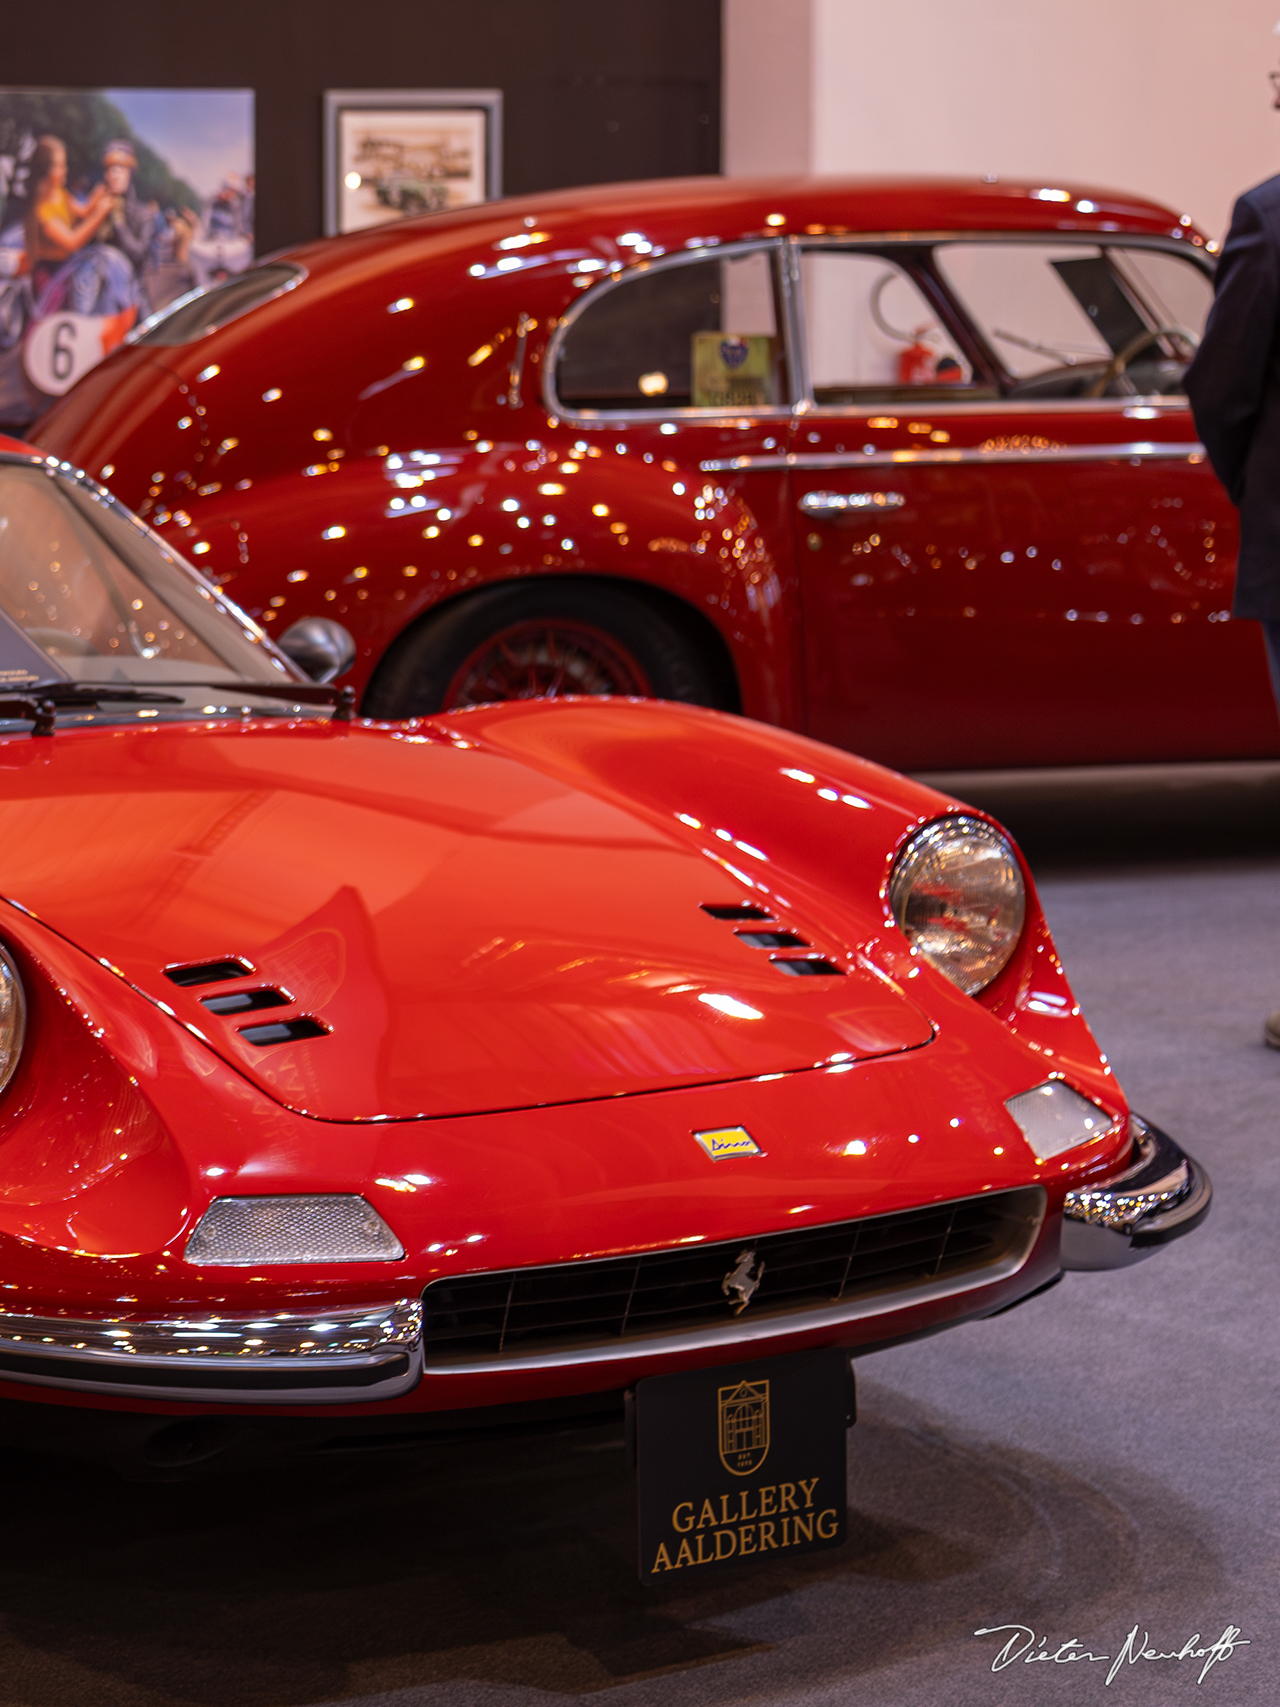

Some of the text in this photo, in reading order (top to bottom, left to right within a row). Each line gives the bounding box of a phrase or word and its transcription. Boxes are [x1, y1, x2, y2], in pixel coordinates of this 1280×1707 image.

[51, 321, 76, 380] 6
[711, 1138, 751, 1152] Dino
[672, 1477, 820, 1533] GALLERY
[651, 1508, 839, 1574] AALDERING
